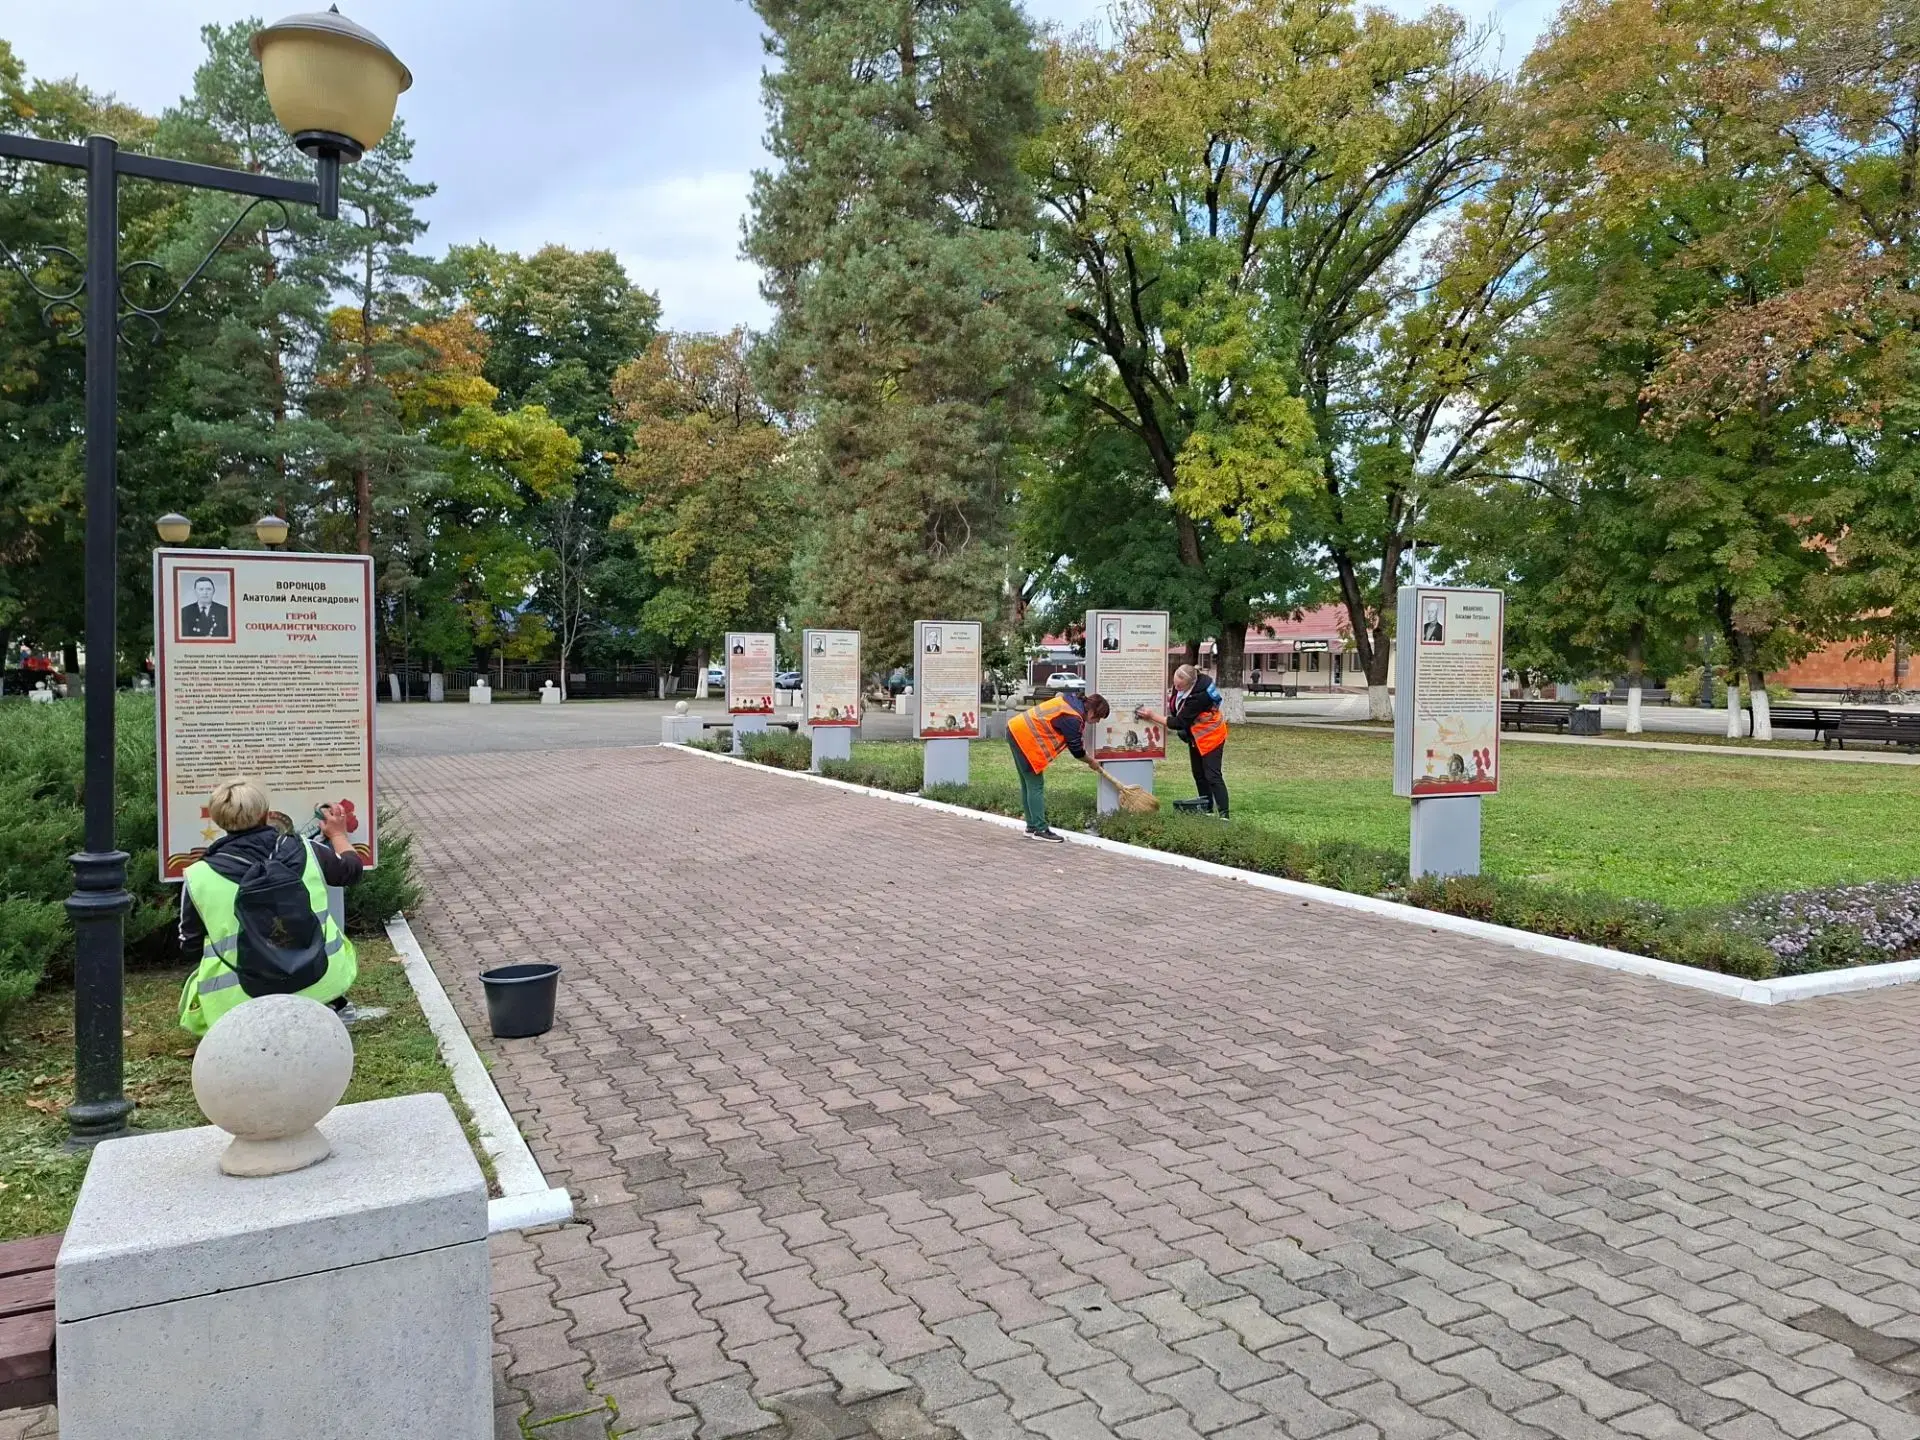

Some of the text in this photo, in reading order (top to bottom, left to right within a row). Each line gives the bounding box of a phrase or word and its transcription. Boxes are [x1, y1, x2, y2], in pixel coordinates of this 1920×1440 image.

[276, 581, 326, 591] ВОРОНЦОВ
[242, 593, 360, 604] Анатолий Александрович
[285, 611, 318, 620] ГЕРОЙ
[245, 623, 357, 631] СОЦИАЛИСТИЧЕСКОГО
[286, 633, 318, 642] ТРУДА
